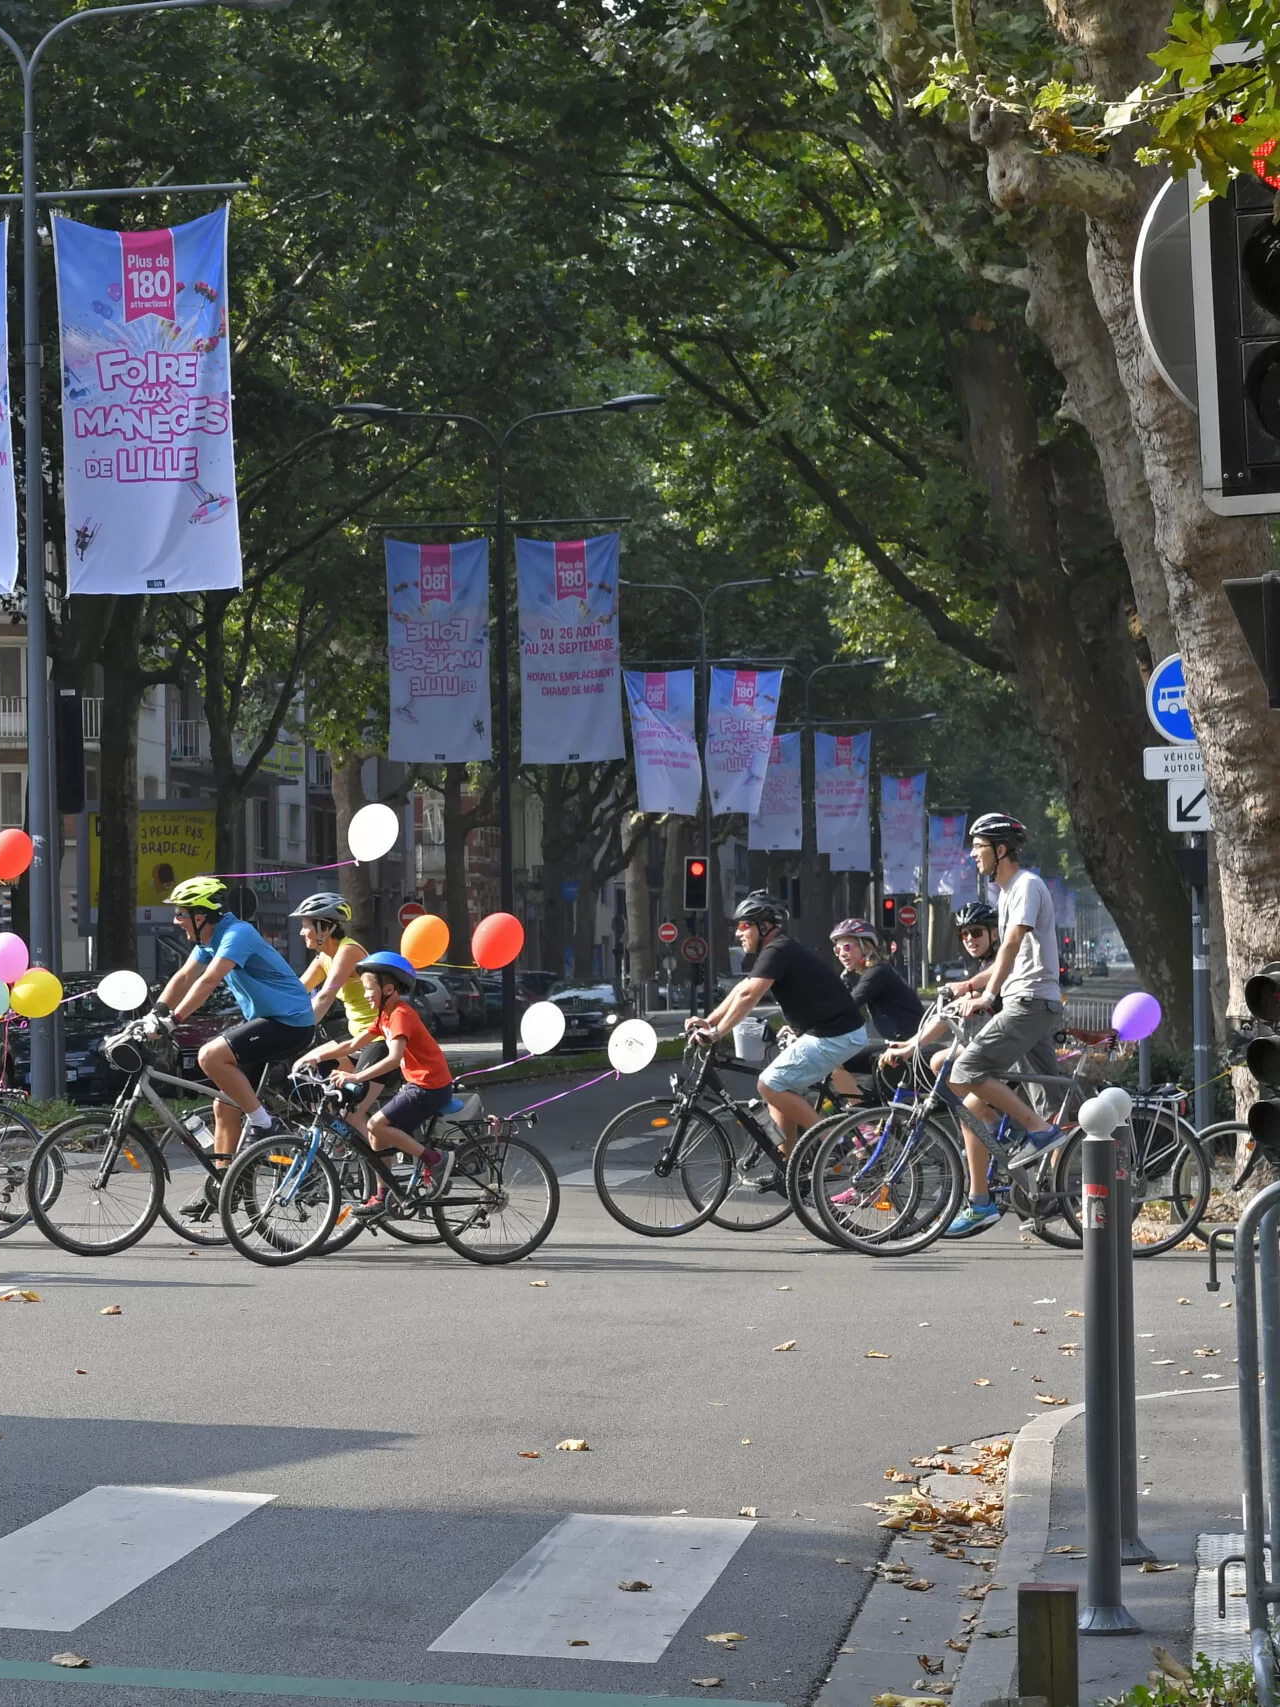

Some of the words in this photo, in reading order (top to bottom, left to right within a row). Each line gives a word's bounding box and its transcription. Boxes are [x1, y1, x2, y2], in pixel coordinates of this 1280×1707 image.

[127, 254, 153, 268] Plus
[156, 253, 170, 267] de
[128, 270, 171, 299] 180
[95, 349, 200, 391] FOIRE
[129, 385, 172, 404] AUX
[85, 458, 113, 479] DE
[115, 446, 200, 482] LILLE
[559, 570, 584, 587] 180
[540, 628, 554, 641] DU
[560, 627, 573, 639] 26
[576, 623, 601, 639] AOÛT
[525, 643, 539, 655] AU
[541, 642, 555, 655] 24
[558, 638, 615, 655] SEPTEMBRE
[526, 671, 557, 682] NOUVEL
[559, 668, 615, 682] EMPLACEMENT
[541, 686, 571, 697] CHAMP
[572, 685, 582, 695] DE
[583, 684, 605, 694] MARS
[736, 687, 754, 698] 180
[1163, 751, 1201, 762] VÉHICU
[1164, 763, 1206, 773] AUTORIS
[141, 841, 200, 857] BRADERIE
